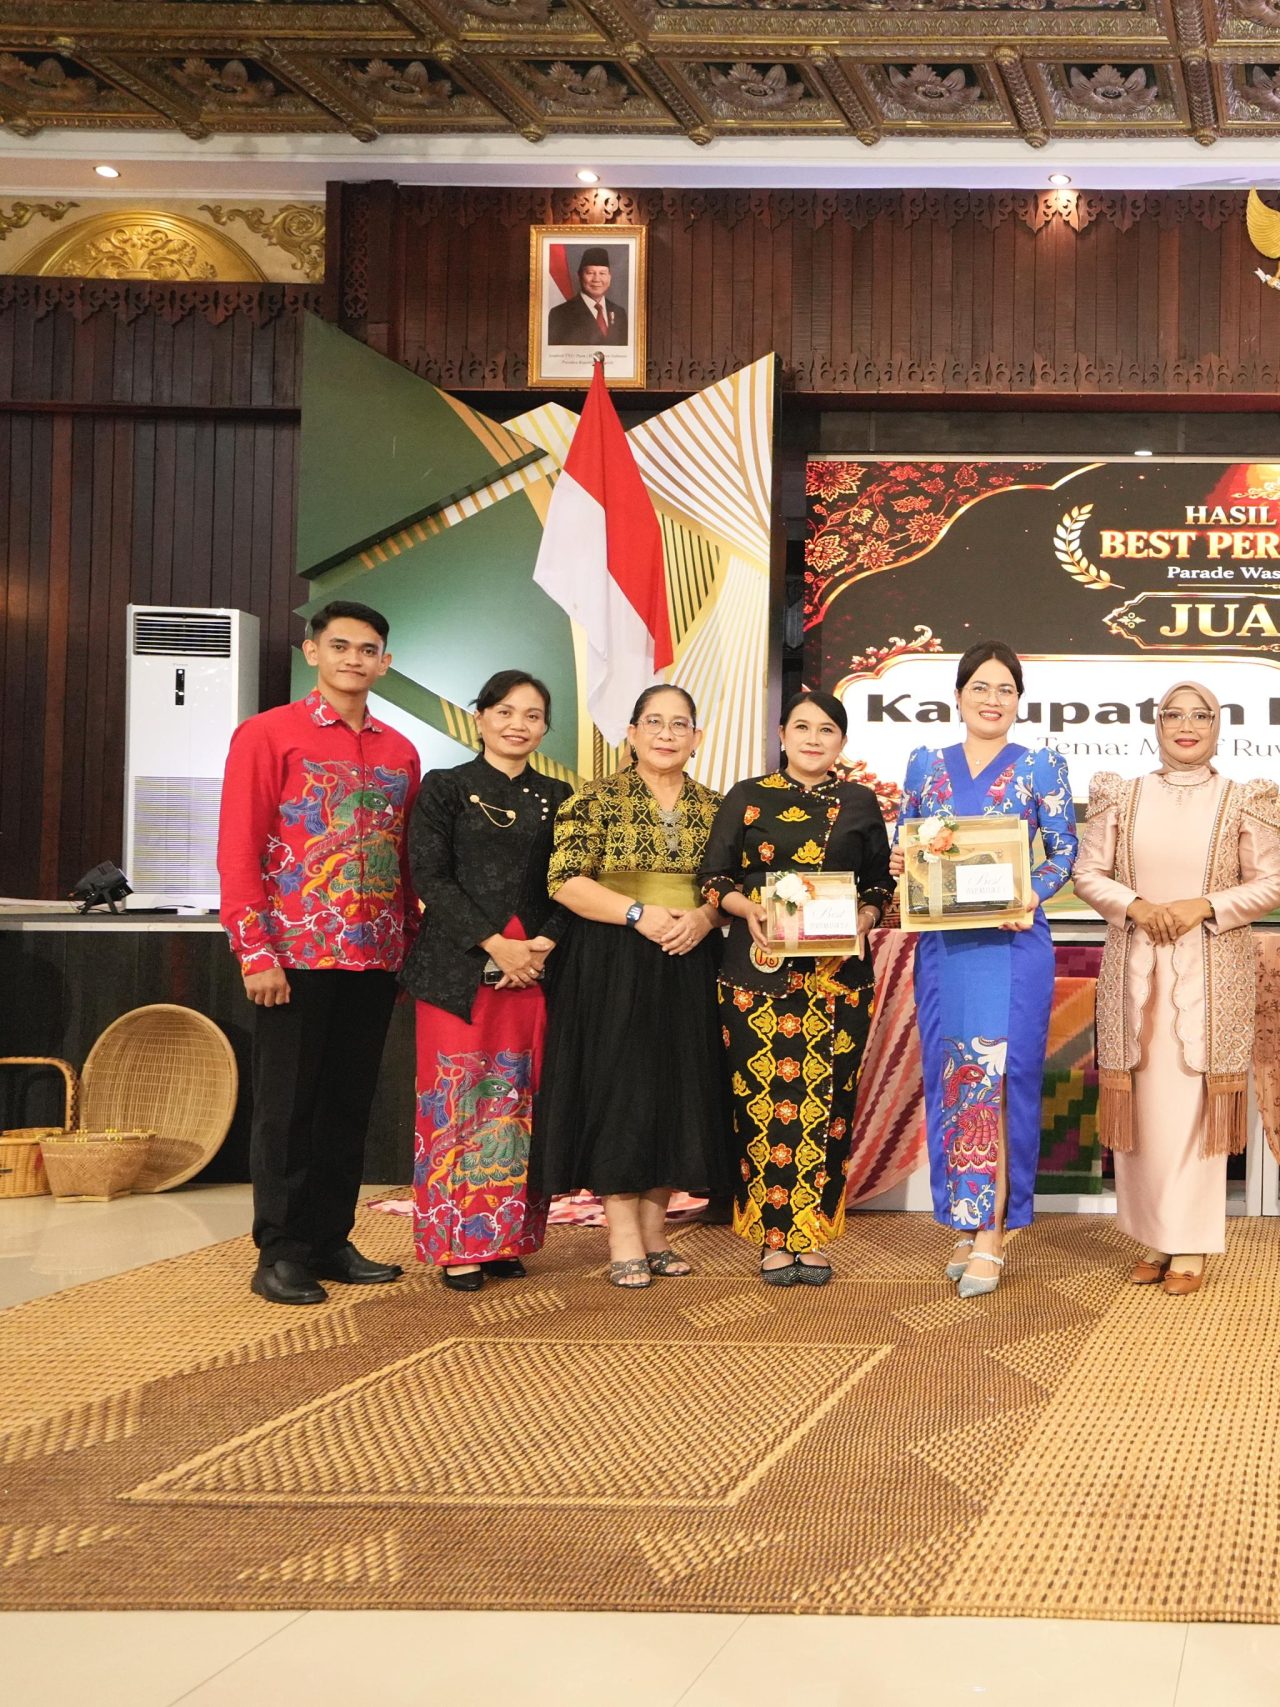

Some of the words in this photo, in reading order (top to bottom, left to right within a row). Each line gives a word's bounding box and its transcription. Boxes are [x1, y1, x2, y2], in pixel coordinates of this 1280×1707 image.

[1184, 505, 1278, 526] HASIL
[1100, 530, 1197, 559] BEST
[1167, 566, 1235, 579] Parade
[867, 693, 1245, 732] Kaupatn
[1036, 736, 1128, 756] Tema:
